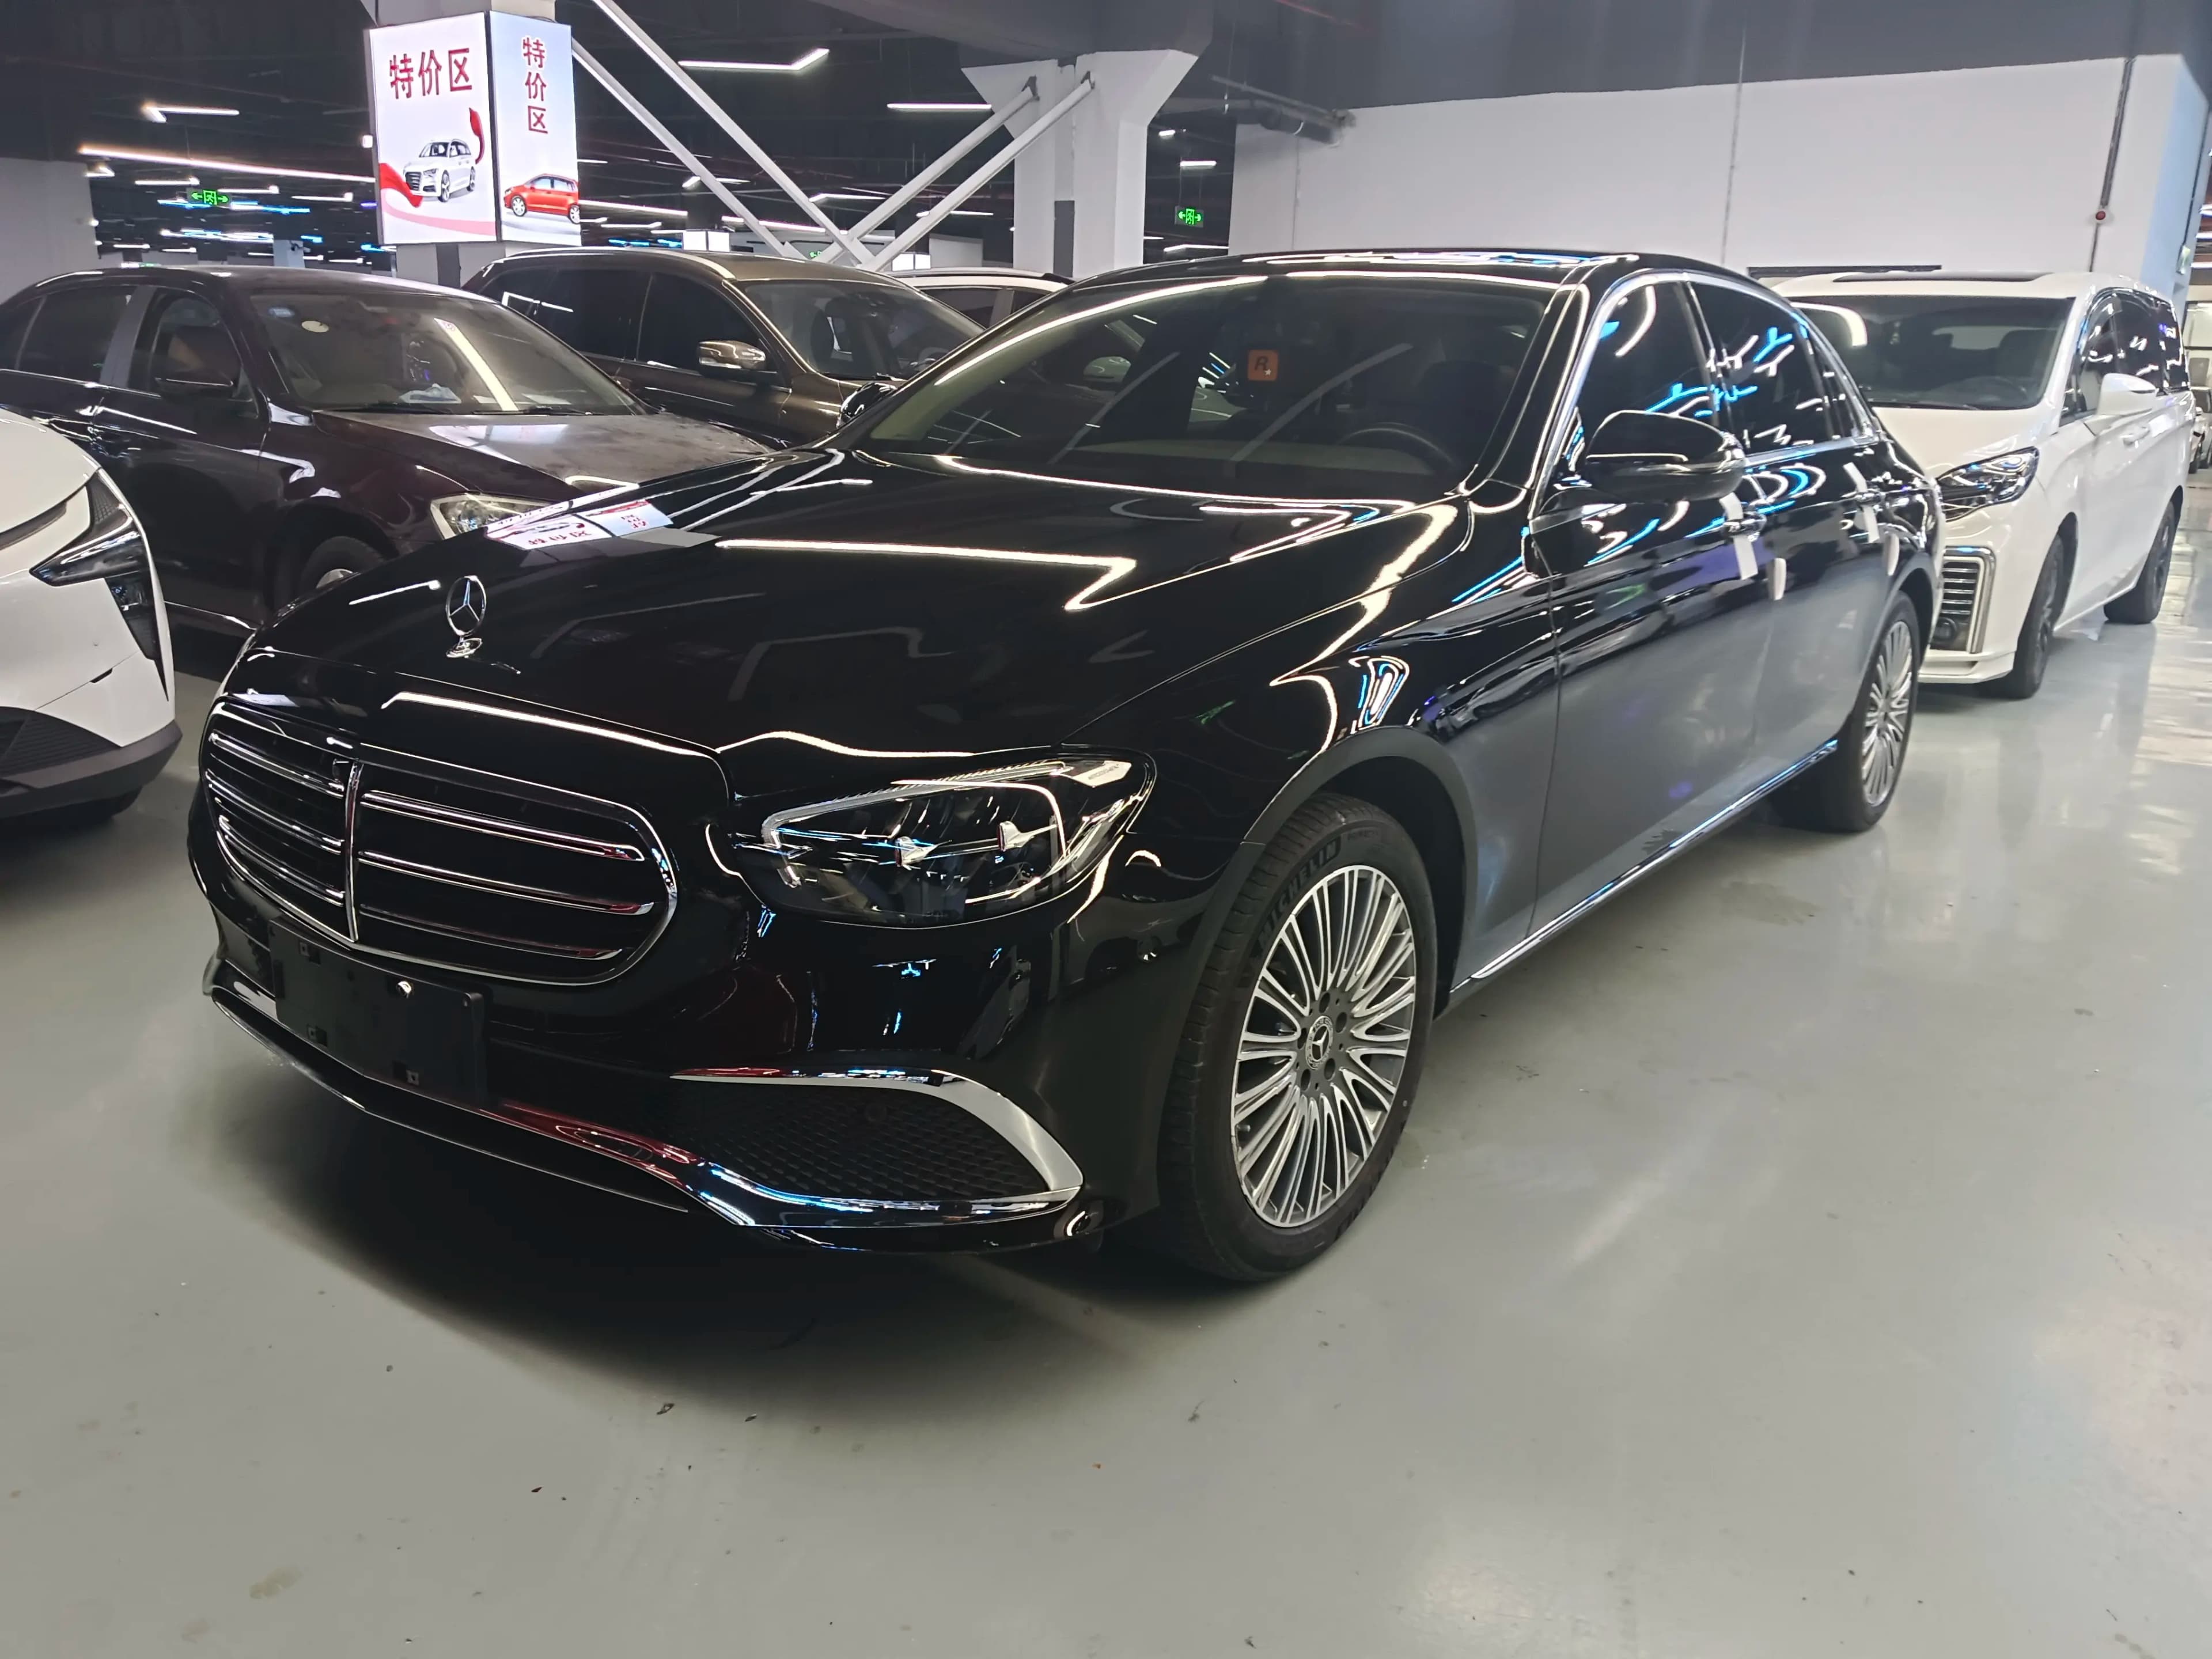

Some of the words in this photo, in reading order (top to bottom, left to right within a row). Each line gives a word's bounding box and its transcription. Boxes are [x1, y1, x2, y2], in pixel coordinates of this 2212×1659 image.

[389, 48, 472, 99] 特价区
[522, 37, 548, 134] 特价区
[1258, 839, 1336, 946] MICHELIN
